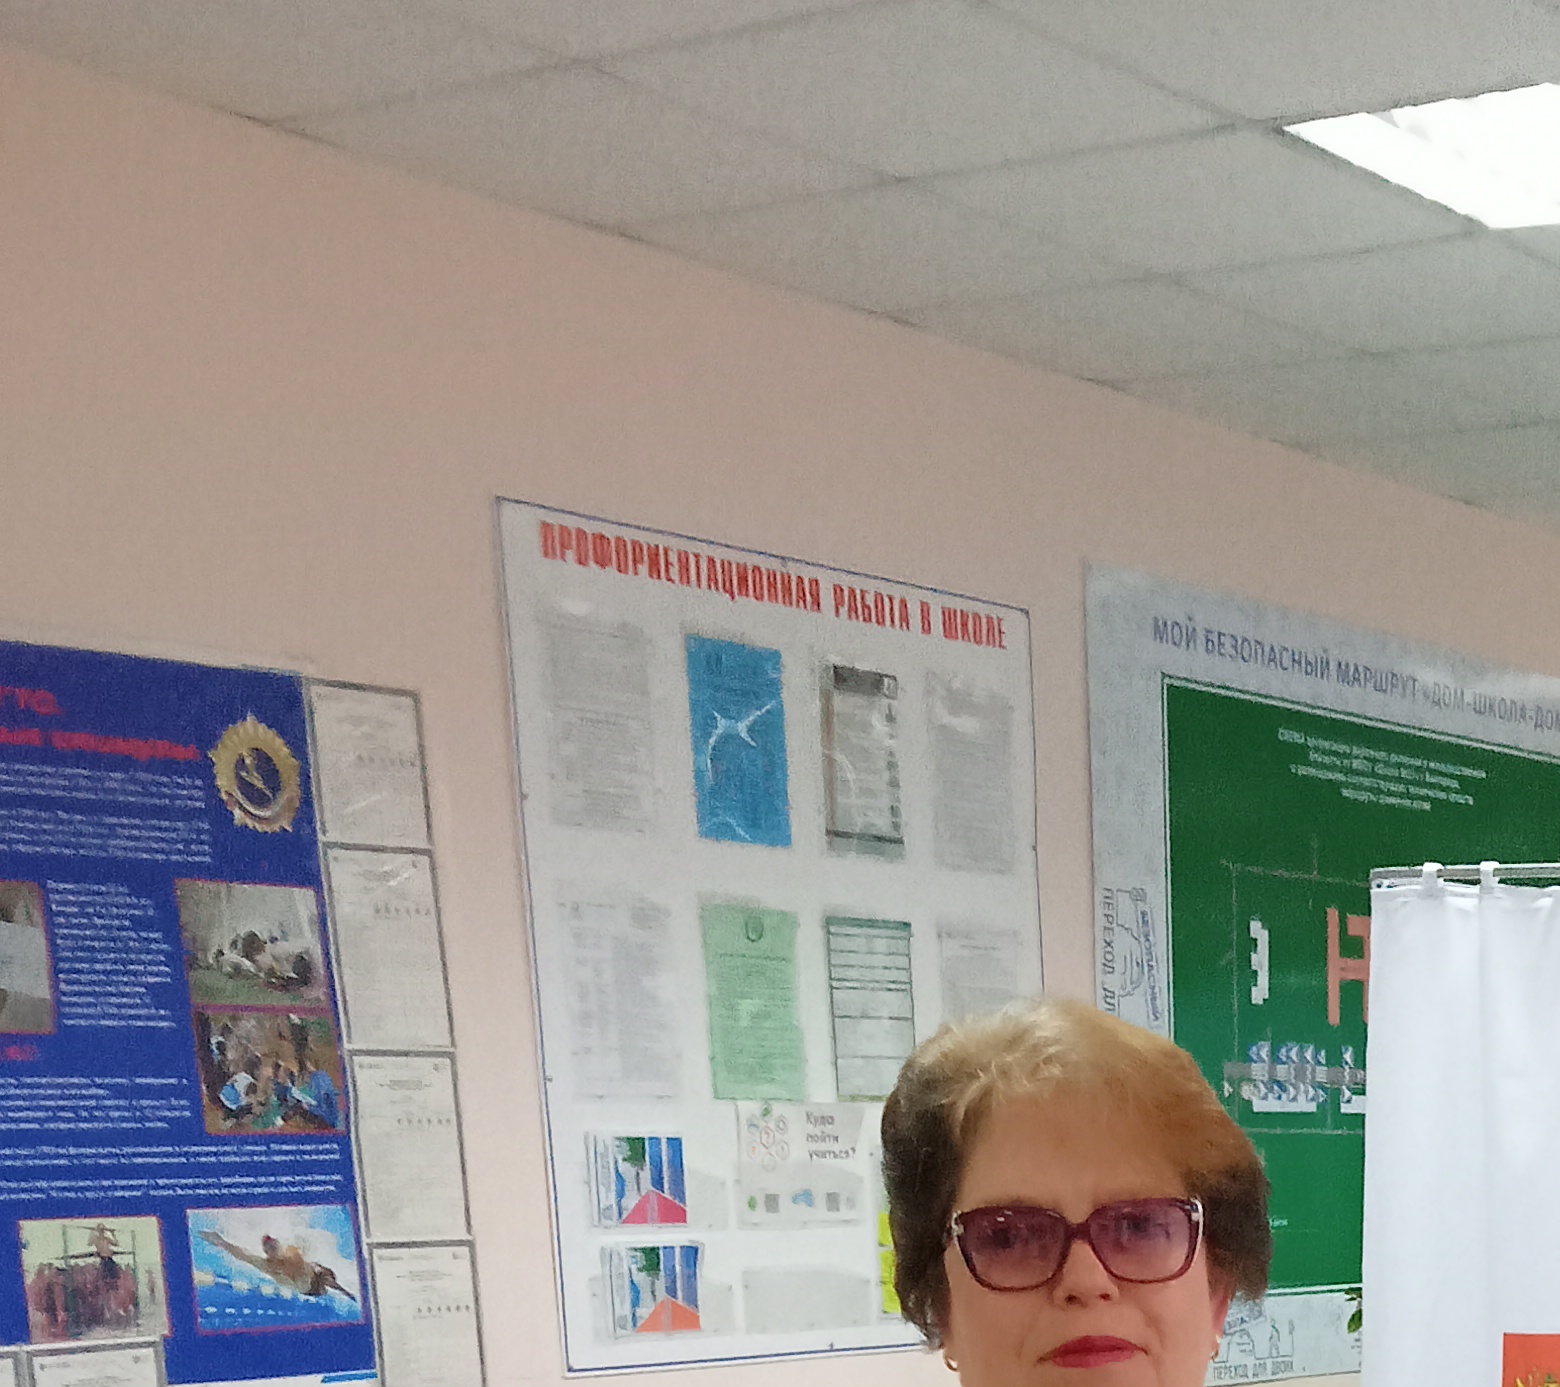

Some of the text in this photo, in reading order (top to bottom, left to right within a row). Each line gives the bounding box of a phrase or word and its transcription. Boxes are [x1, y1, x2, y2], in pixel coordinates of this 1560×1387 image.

[539, 520, 1007, 650] ПРОФОРИЕНТАЦИОННАЯ РАБОТА В ШКОЛЕ
[1153, 615, 1198, 651] МОЙ
[1203, 627, 1331, 681] БЕЗОПАСНЫЙ
[1336, 658, 1419, 699] МАРШРУТ
